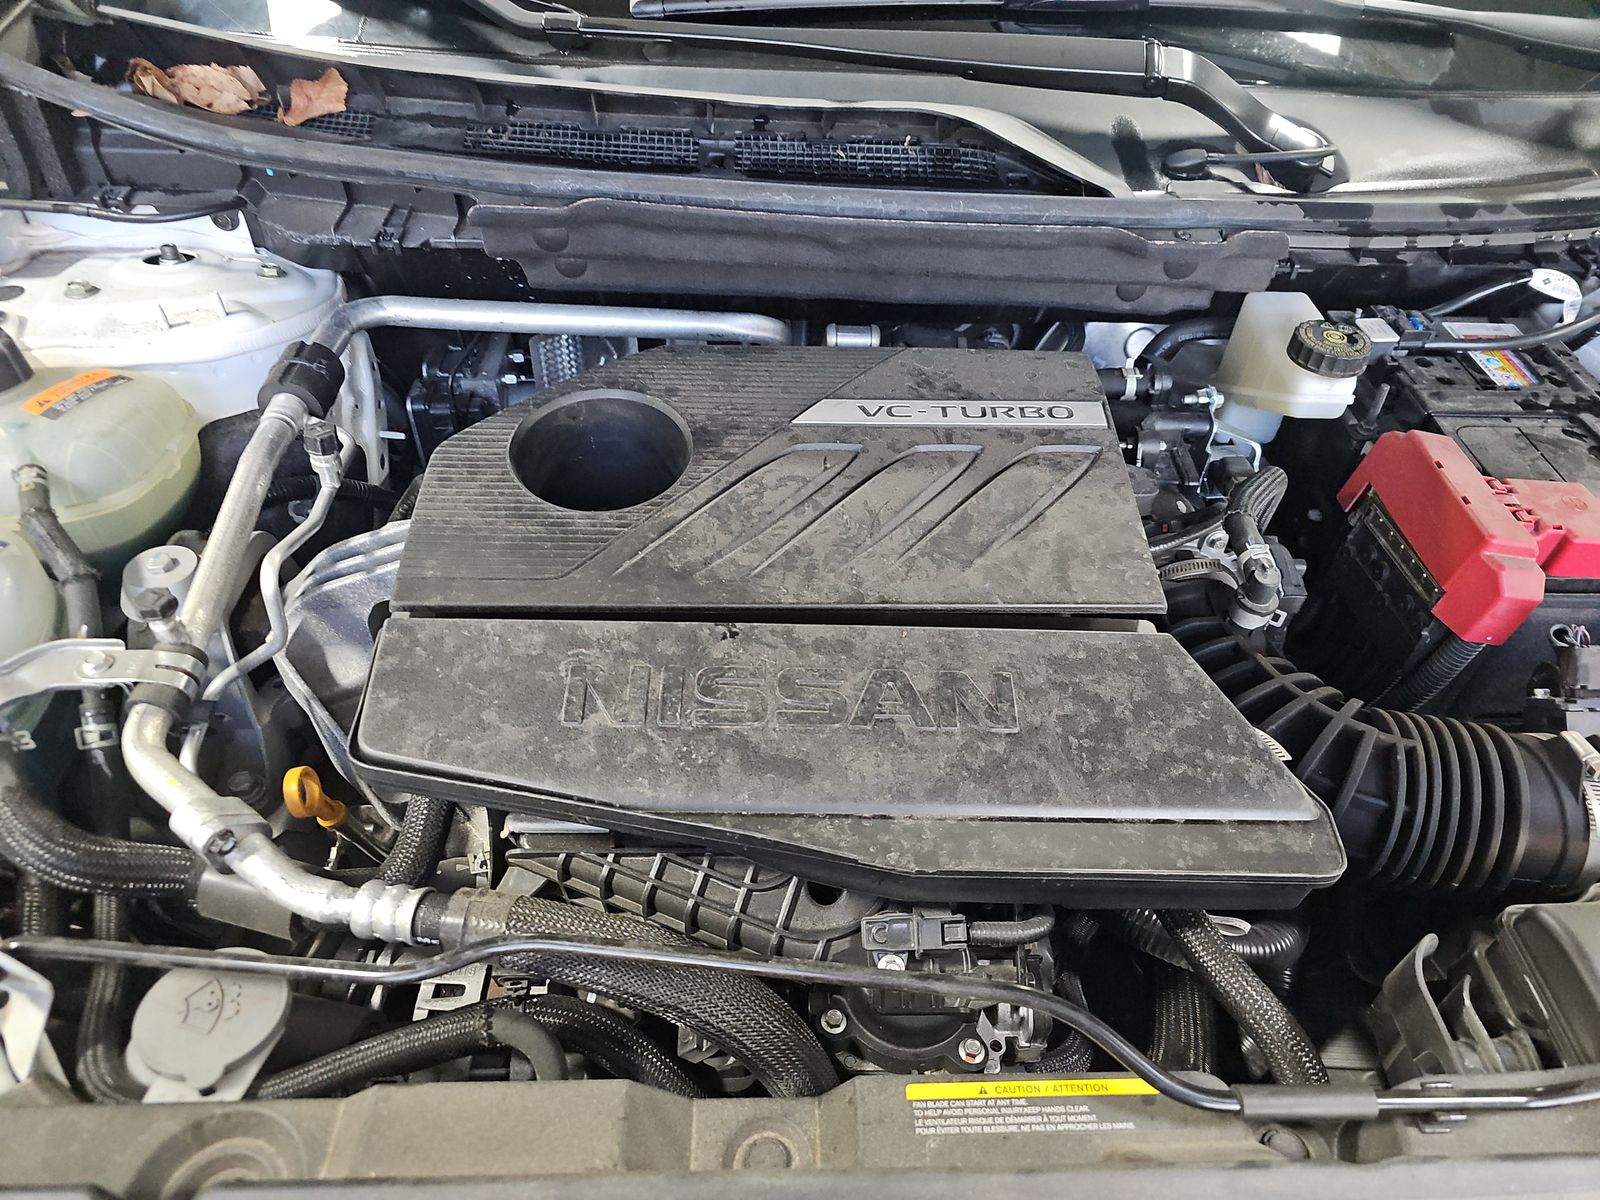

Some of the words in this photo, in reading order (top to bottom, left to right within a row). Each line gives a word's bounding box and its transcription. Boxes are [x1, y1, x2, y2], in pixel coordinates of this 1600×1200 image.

[856, 404, 1074, 419] VC-TURBO
[559, 664, 1020, 734] NISSAN
[994, 1085, 1041, 1095] CAUTION
[1053, 1083, 1109, 1093] ATTENTION
[912, 1100, 926, 1108] FAN
[927, 1100, 949, 1108] BLADE
[966, 1099, 985, 1107] START
[987, 1099, 995, 1107] AT
[996, 1098, 1010, 1106] ANY
[913, 1109, 924, 1117] TO
[942, 1108, 964, 1116] AVOID
[964, 1107, 1001, 1116] PERSONAL
[1042, 1105, 1065, 1113] HANDS
[914, 1118, 924, 1126] LE
[925, 1117, 968, 1126] VENTILATEUR
[969, 1116, 995, 1125] RISQUE
[995, 1116, 1004, 1124] DE
[1049, 1114, 1066, 1122] TOUT
[915, 1127, 936, 1135] POUR
[960, 1126, 982, 1134] TOUTE
[1021, 1124, 1031, 1132] NE
[1031, 1124, 1046, 1132] PAS
[1056, 1122, 1099, 1131] APPROCHER
[1099, 1122, 1112, 1130] LES
